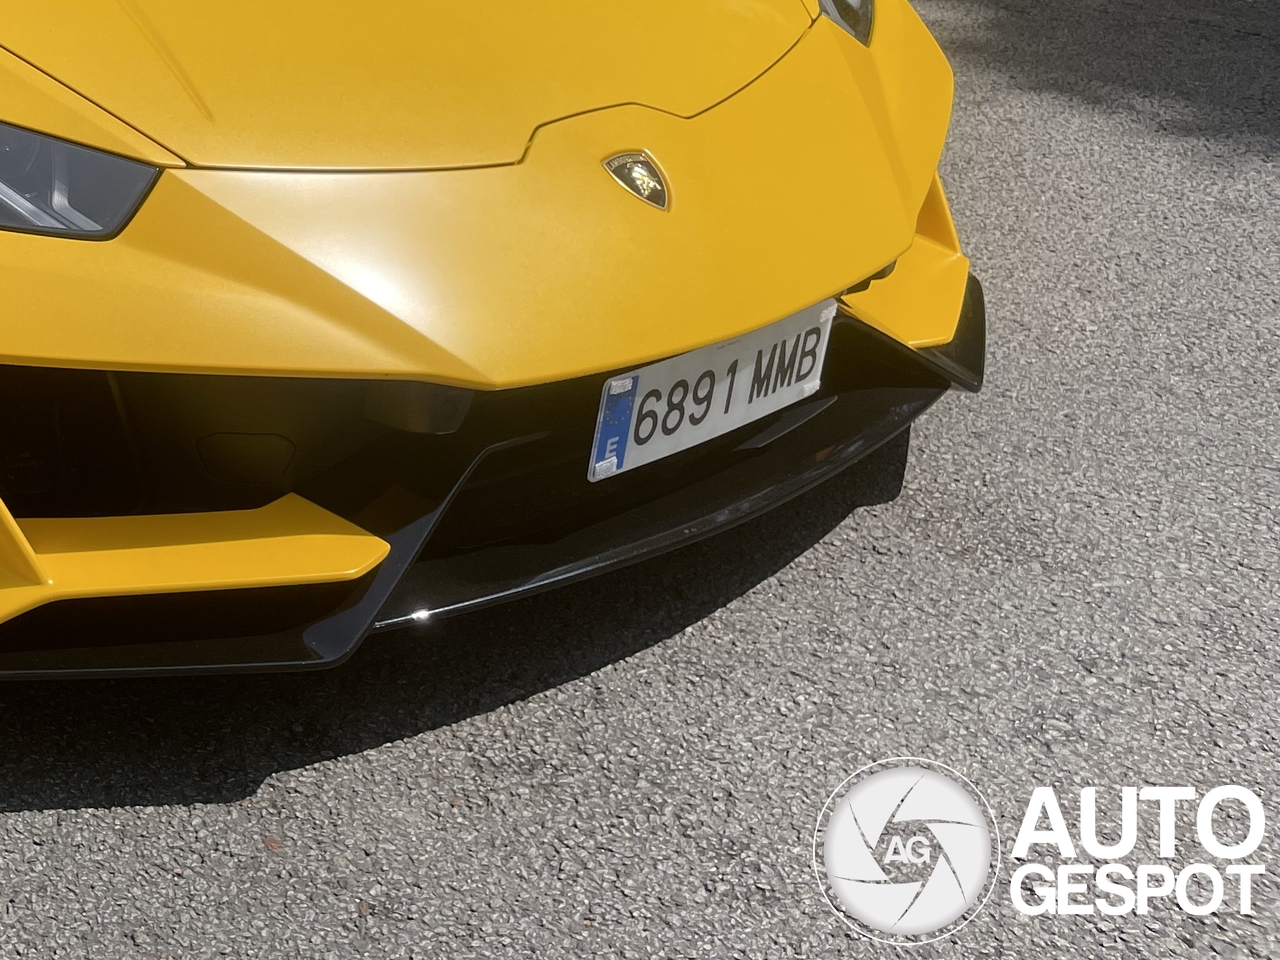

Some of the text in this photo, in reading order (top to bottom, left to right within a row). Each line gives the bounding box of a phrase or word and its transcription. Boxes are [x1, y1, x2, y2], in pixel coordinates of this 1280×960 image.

[633, 326, 821, 446] 6891 MMB
[605, 436, 620, 458] E
